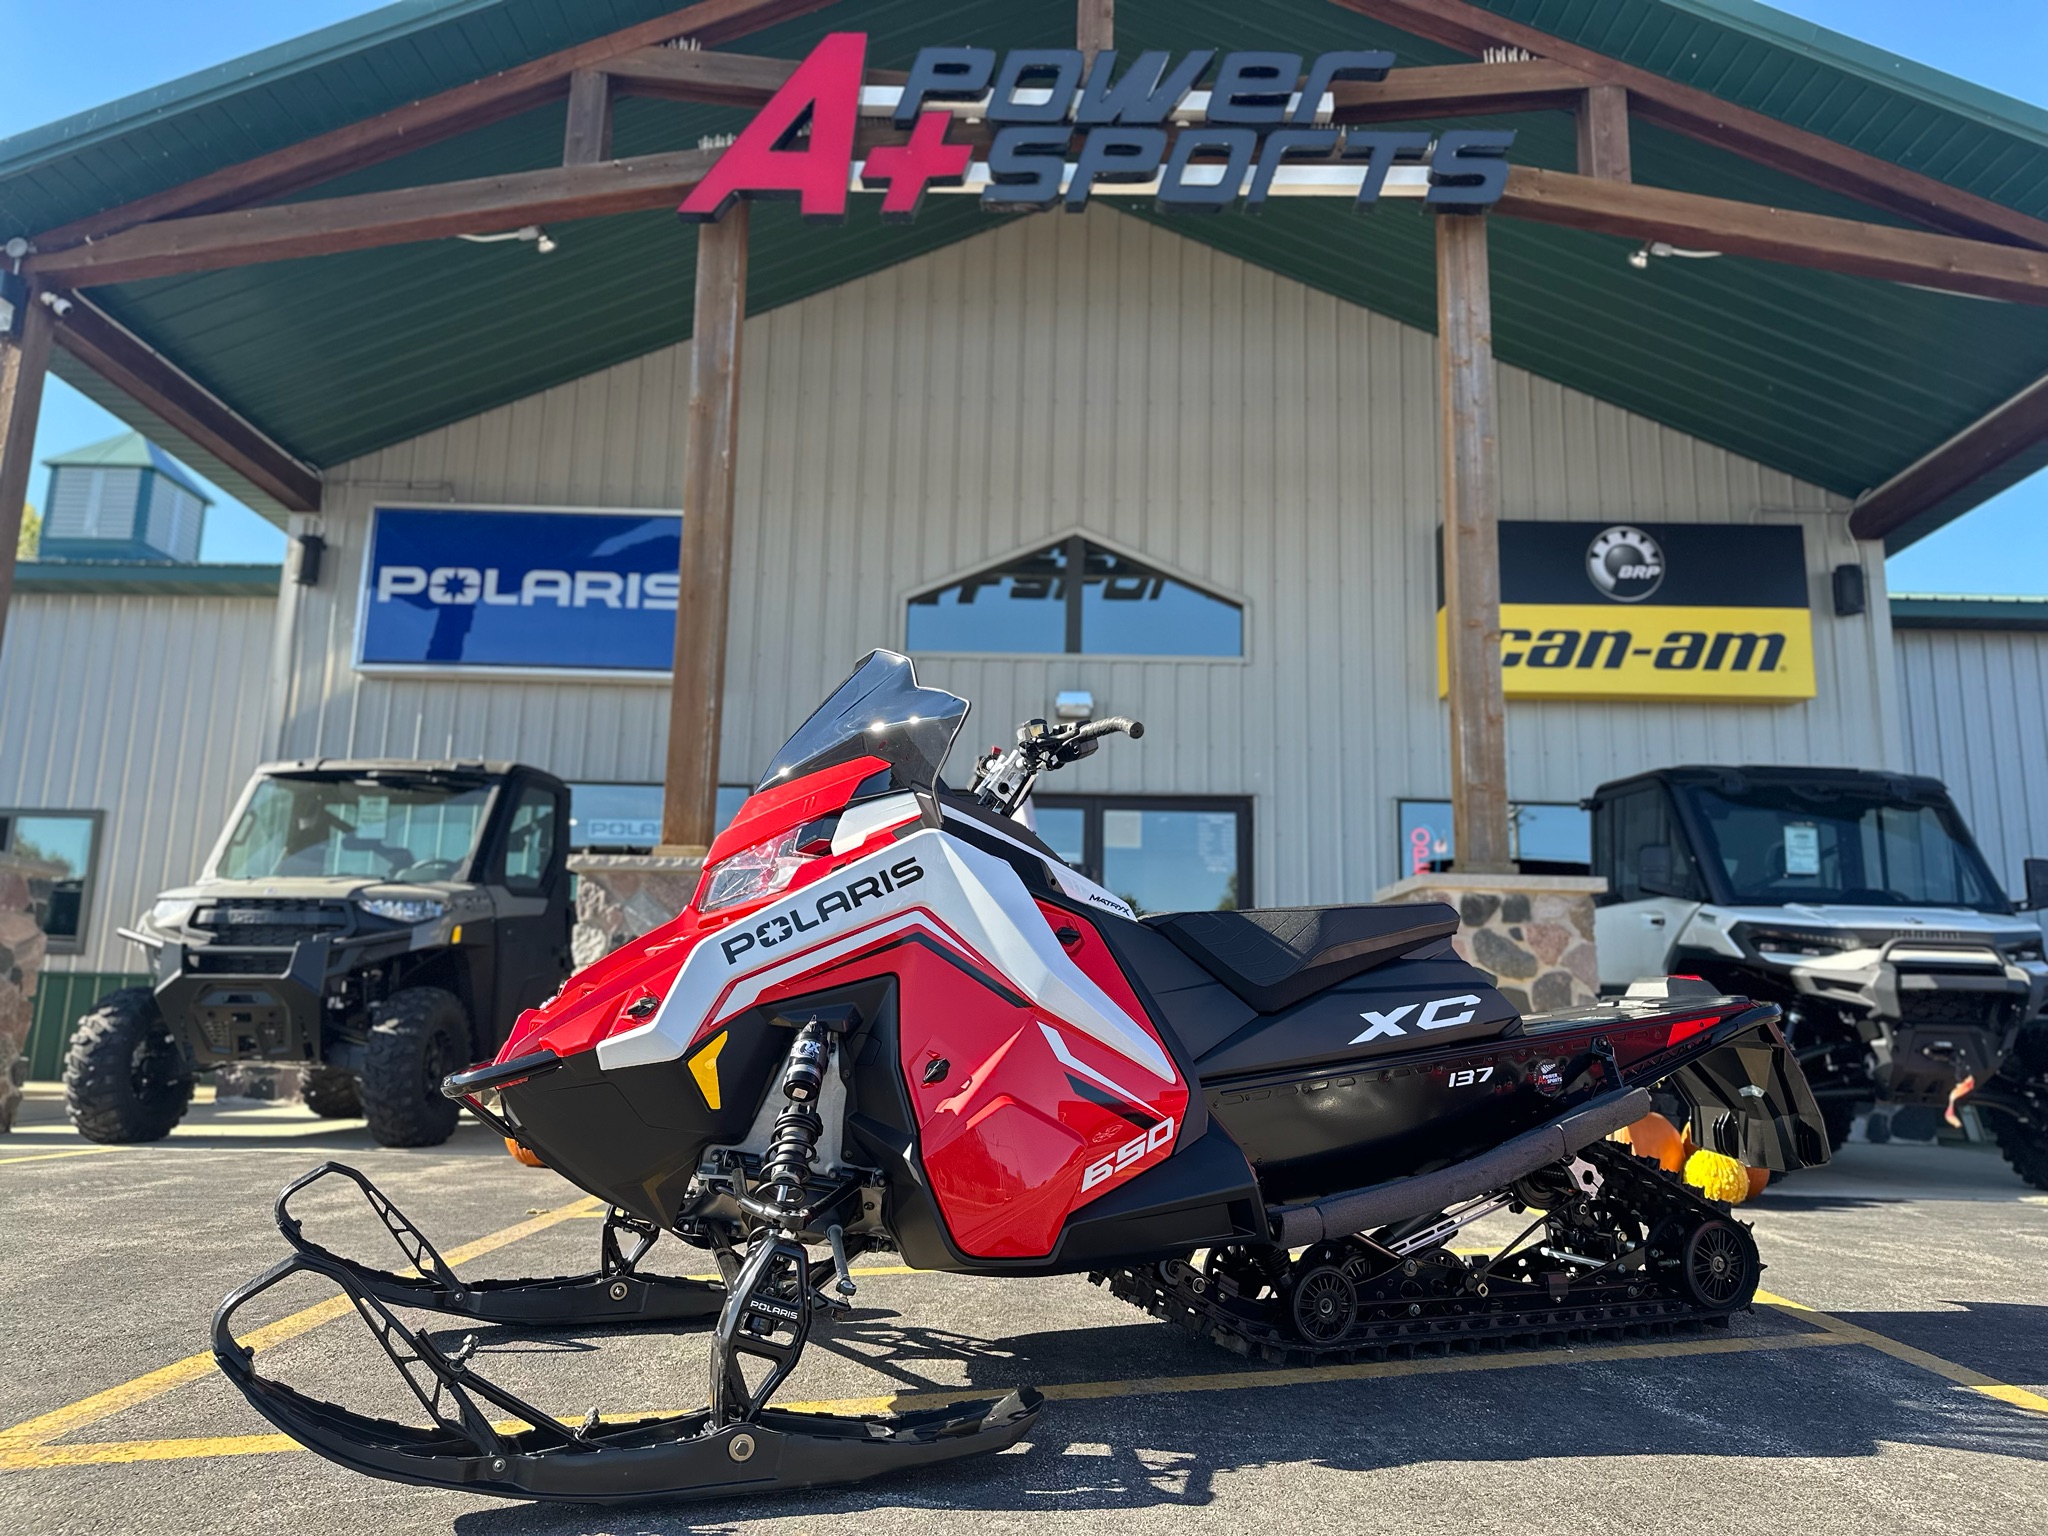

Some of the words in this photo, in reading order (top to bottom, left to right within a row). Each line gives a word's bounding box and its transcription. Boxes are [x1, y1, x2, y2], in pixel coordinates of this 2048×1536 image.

[677, 32, 973, 223] A+
[377, 566, 681, 610] POLARIS
[1618, 564, 1661, 580] BRP
[591, 822, 661, 836] POLA
[721, 857, 925, 965] POLARIS
[1089, 894, 1130, 917] MATRYX
[1348, 994, 1482, 1045] XC
[1448, 1066, 1494, 1088] 137
[1081, 1116, 1175, 1194] 650
[750, 1300, 798, 1320] POLARIS
